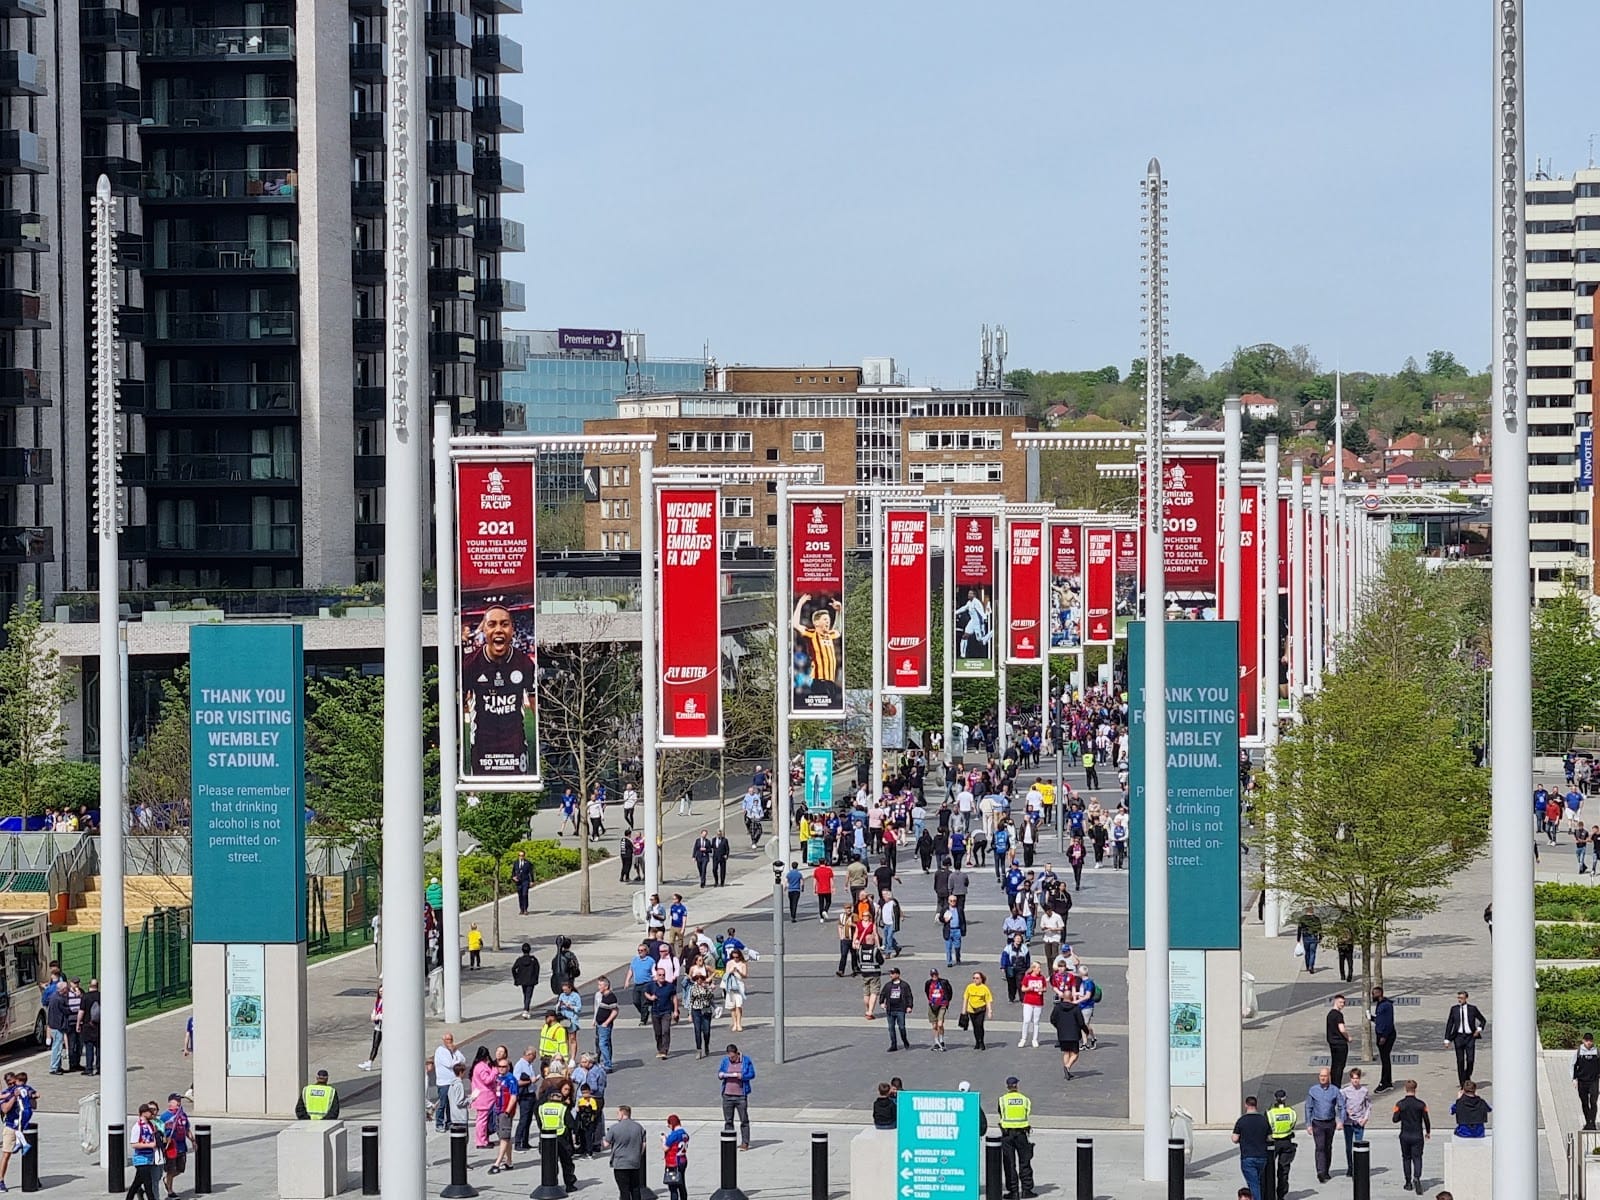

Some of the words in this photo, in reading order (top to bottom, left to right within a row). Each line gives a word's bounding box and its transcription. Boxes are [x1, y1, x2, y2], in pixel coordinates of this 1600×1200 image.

[564, 334, 592, 344] Premier
[593, 336, 604, 344] Inn
[1584, 434, 1592, 479] NOVOTEL
[667, 502, 712, 518] WELCOME
[478, 521, 514, 535] 2021
[667, 519, 678, 534] TO
[681, 519, 699, 534] THE
[891, 521, 924, 532] WELCOME
[1162, 518, 1197, 532] 2019
[891, 532, 900, 542] TO
[901, 532, 914, 542] THE
[1013, 529, 1040, 538] WELCOME
[667, 534, 712, 550] EMIRATES
[805, 541, 830, 551] 2015
[891, 544, 924, 554] EMIRATES
[1013, 547, 1039, 555] EMIRATES
[667, 550, 678, 566] FA
[680, 550, 700, 566] CUP
[891, 555, 899, 566] FA
[900, 555, 915, 566] CUP
[1013, 556, 1020, 564] FA
[1021, 556, 1032, 564] CUP
[668, 667, 680, 678] FLY
[681, 667, 707, 678] BETTER
[201, 689, 251, 703] THANK
[255, 689, 285, 703] YOU
[1140, 688, 1193, 702] TANK
[1197, 687, 1229, 702] YOU
[485, 704, 516, 715] POWER
[196, 711, 224, 724] FOR
[227, 711, 292, 724] VISITING
[1168, 709, 1235, 724] VISITING
[208, 732, 280, 746] WEMBLEY
[1166, 732, 1222, 746] MBLEY
[208, 753, 280, 767] STADIUM.
[1167, 753, 1222, 768] ADIUM.
[199, 784, 234, 796] Please
[236, 784, 290, 796] remember
[1177, 786, 1234, 797] remember
[211, 802, 232, 812] that
[235, 802, 278, 815] drinking
[1176, 803, 1220, 816] drinking
[209, 818, 247, 829] alcohol
[251, 818, 259, 829] is
[263, 819, 280, 829] not
[1192, 820, 1201, 831] is
[1205, 822, 1223, 831] not
[209, 835, 260, 848] permitted
[263, 837, 280, 846] on-
[1168, 837, 1201, 848] mitted
[1205, 840, 1223, 848] on-
[228, 853, 262, 862] street.
[1168, 856, 1203, 865] street.
[912, 1097, 946, 1110] THANKS
[947, 1097, 964, 1111] FOR
[920, 1112, 957, 1125] VISITING
[916, 1125, 959, 1139] WEMBLEY
